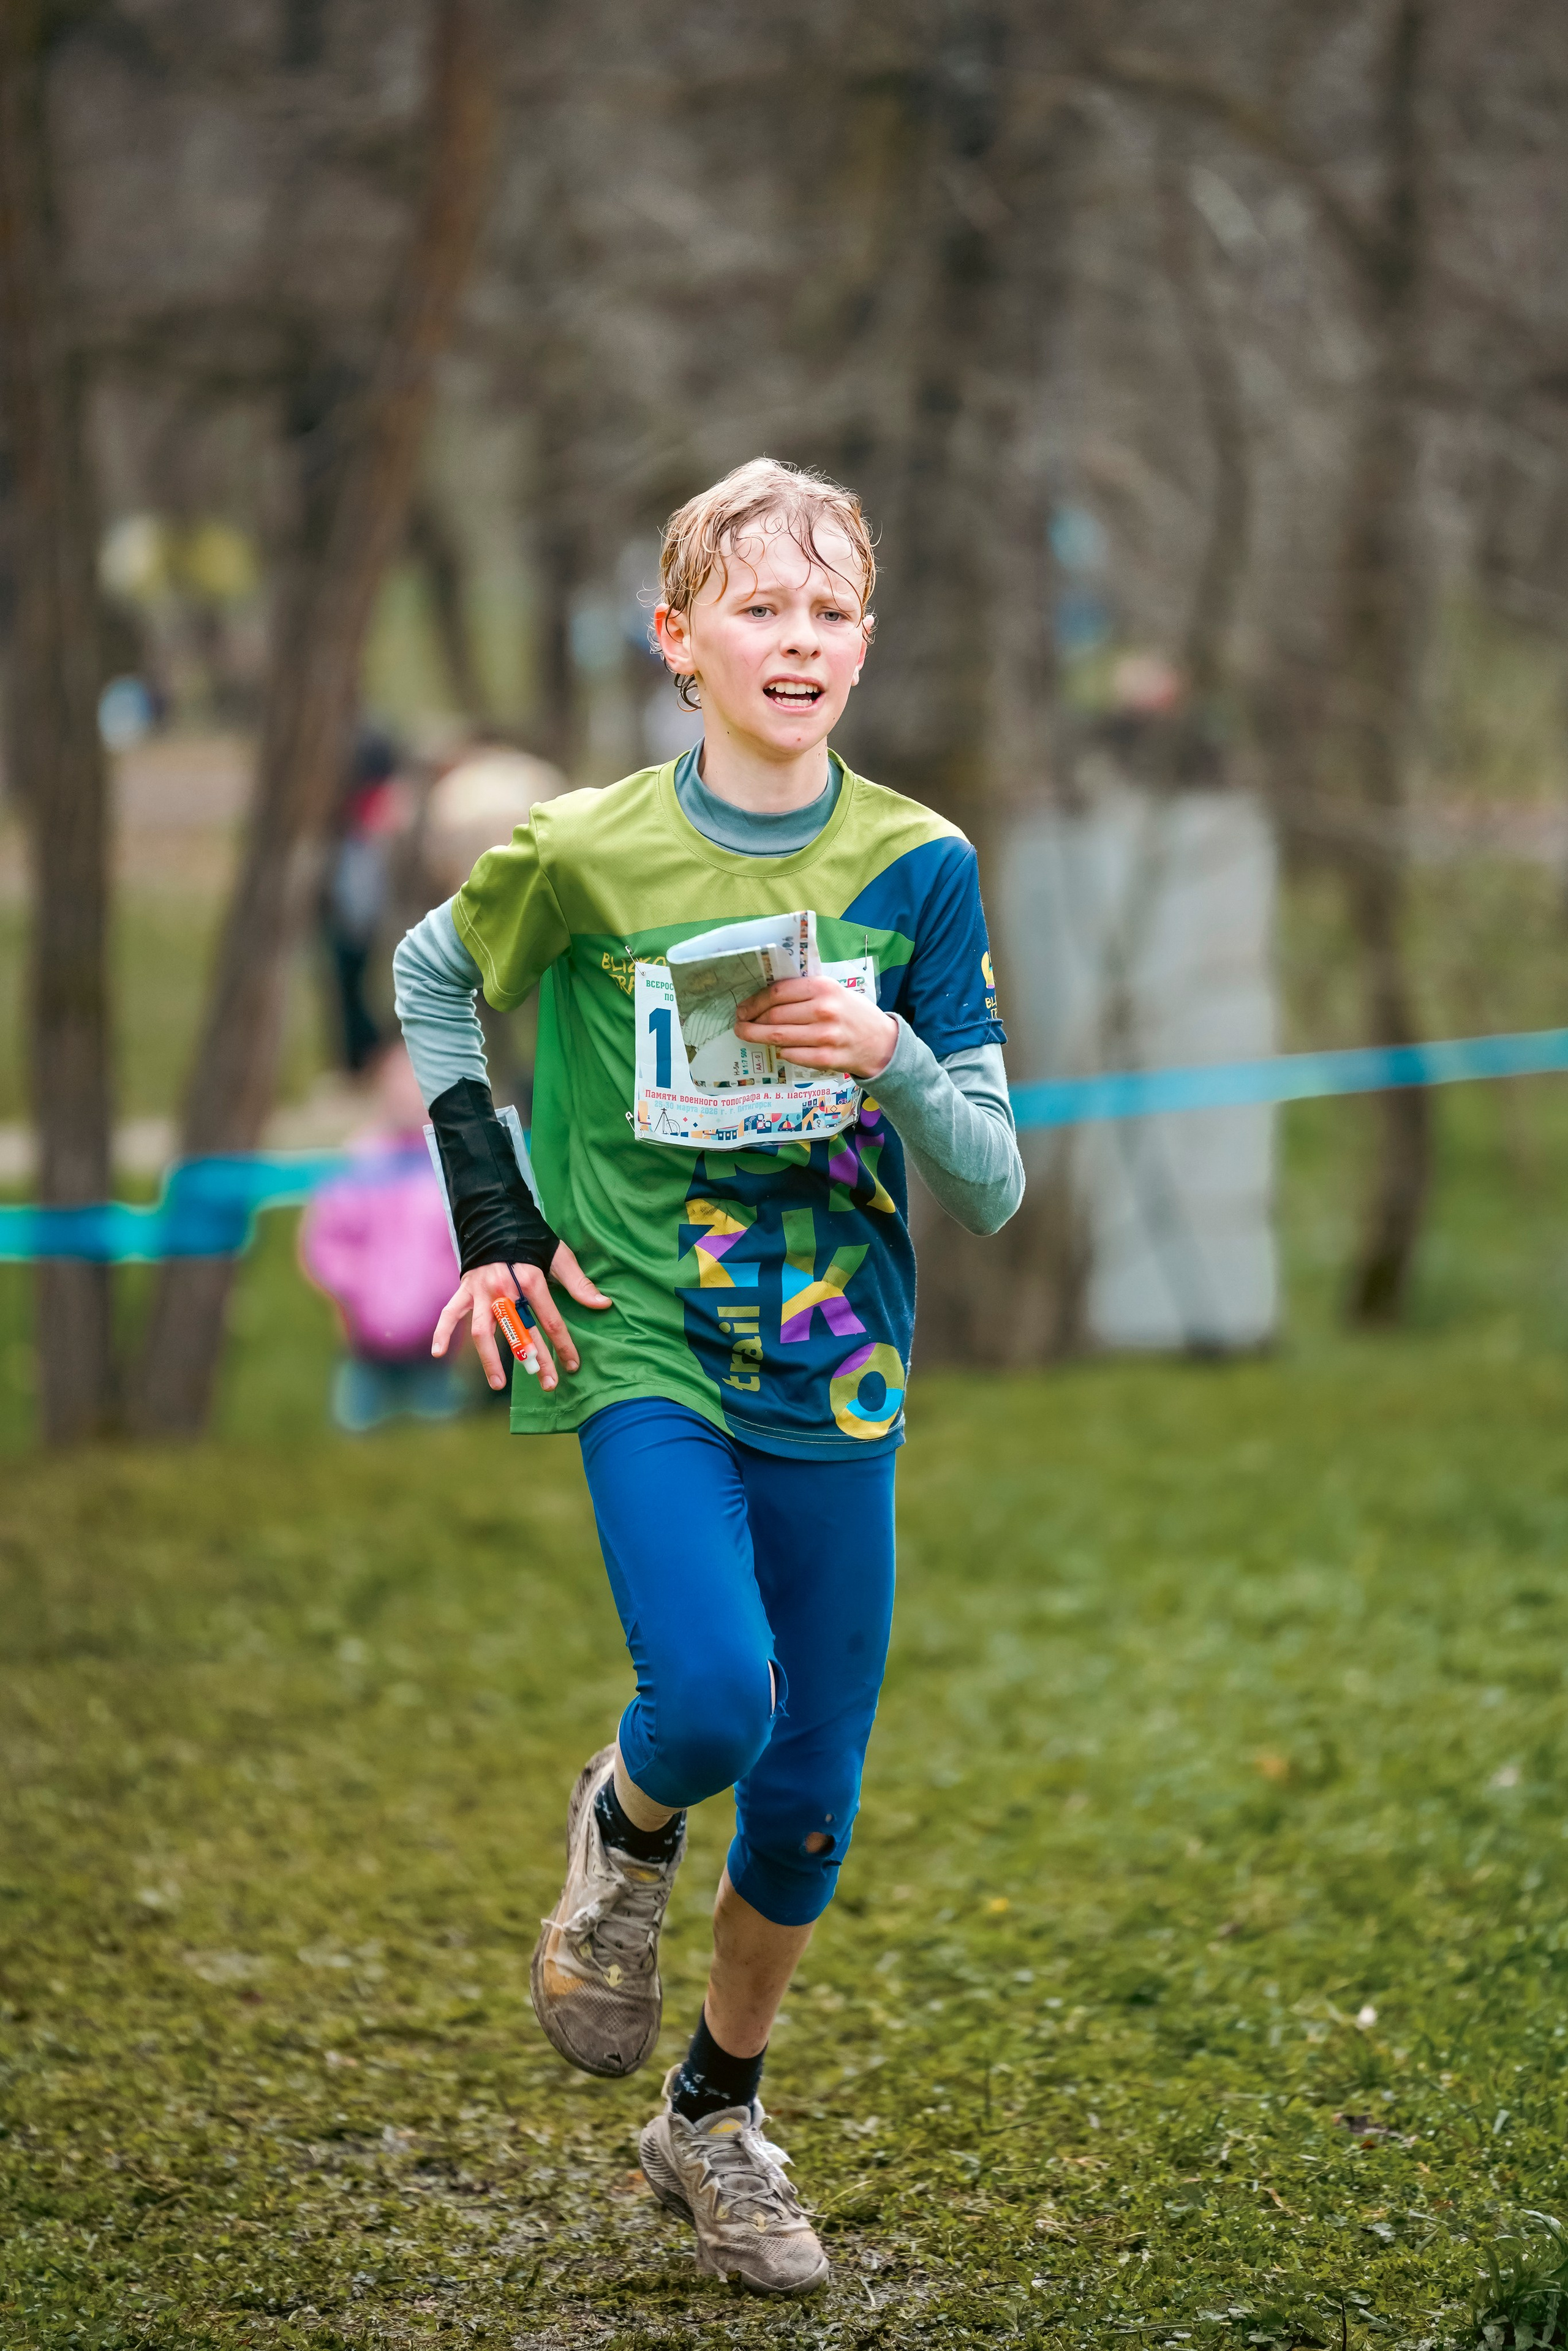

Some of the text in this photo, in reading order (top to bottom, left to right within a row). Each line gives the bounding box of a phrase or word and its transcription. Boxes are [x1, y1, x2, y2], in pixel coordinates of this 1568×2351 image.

[664, 993, 674, 1002] ПО
[649, 1008, 671, 1089] 1
[645, 1089, 677, 1101] Памяти
[680, 1095, 718, 1106] военного
[721, 1093, 761, 1106] топографа
[787, 1088, 831, 1100] Пастухова
[676, 1104, 698, 1113] марта
[737, 1101, 772, 1113] Пятигорск
[717, 1305, 764, 1392] trail
